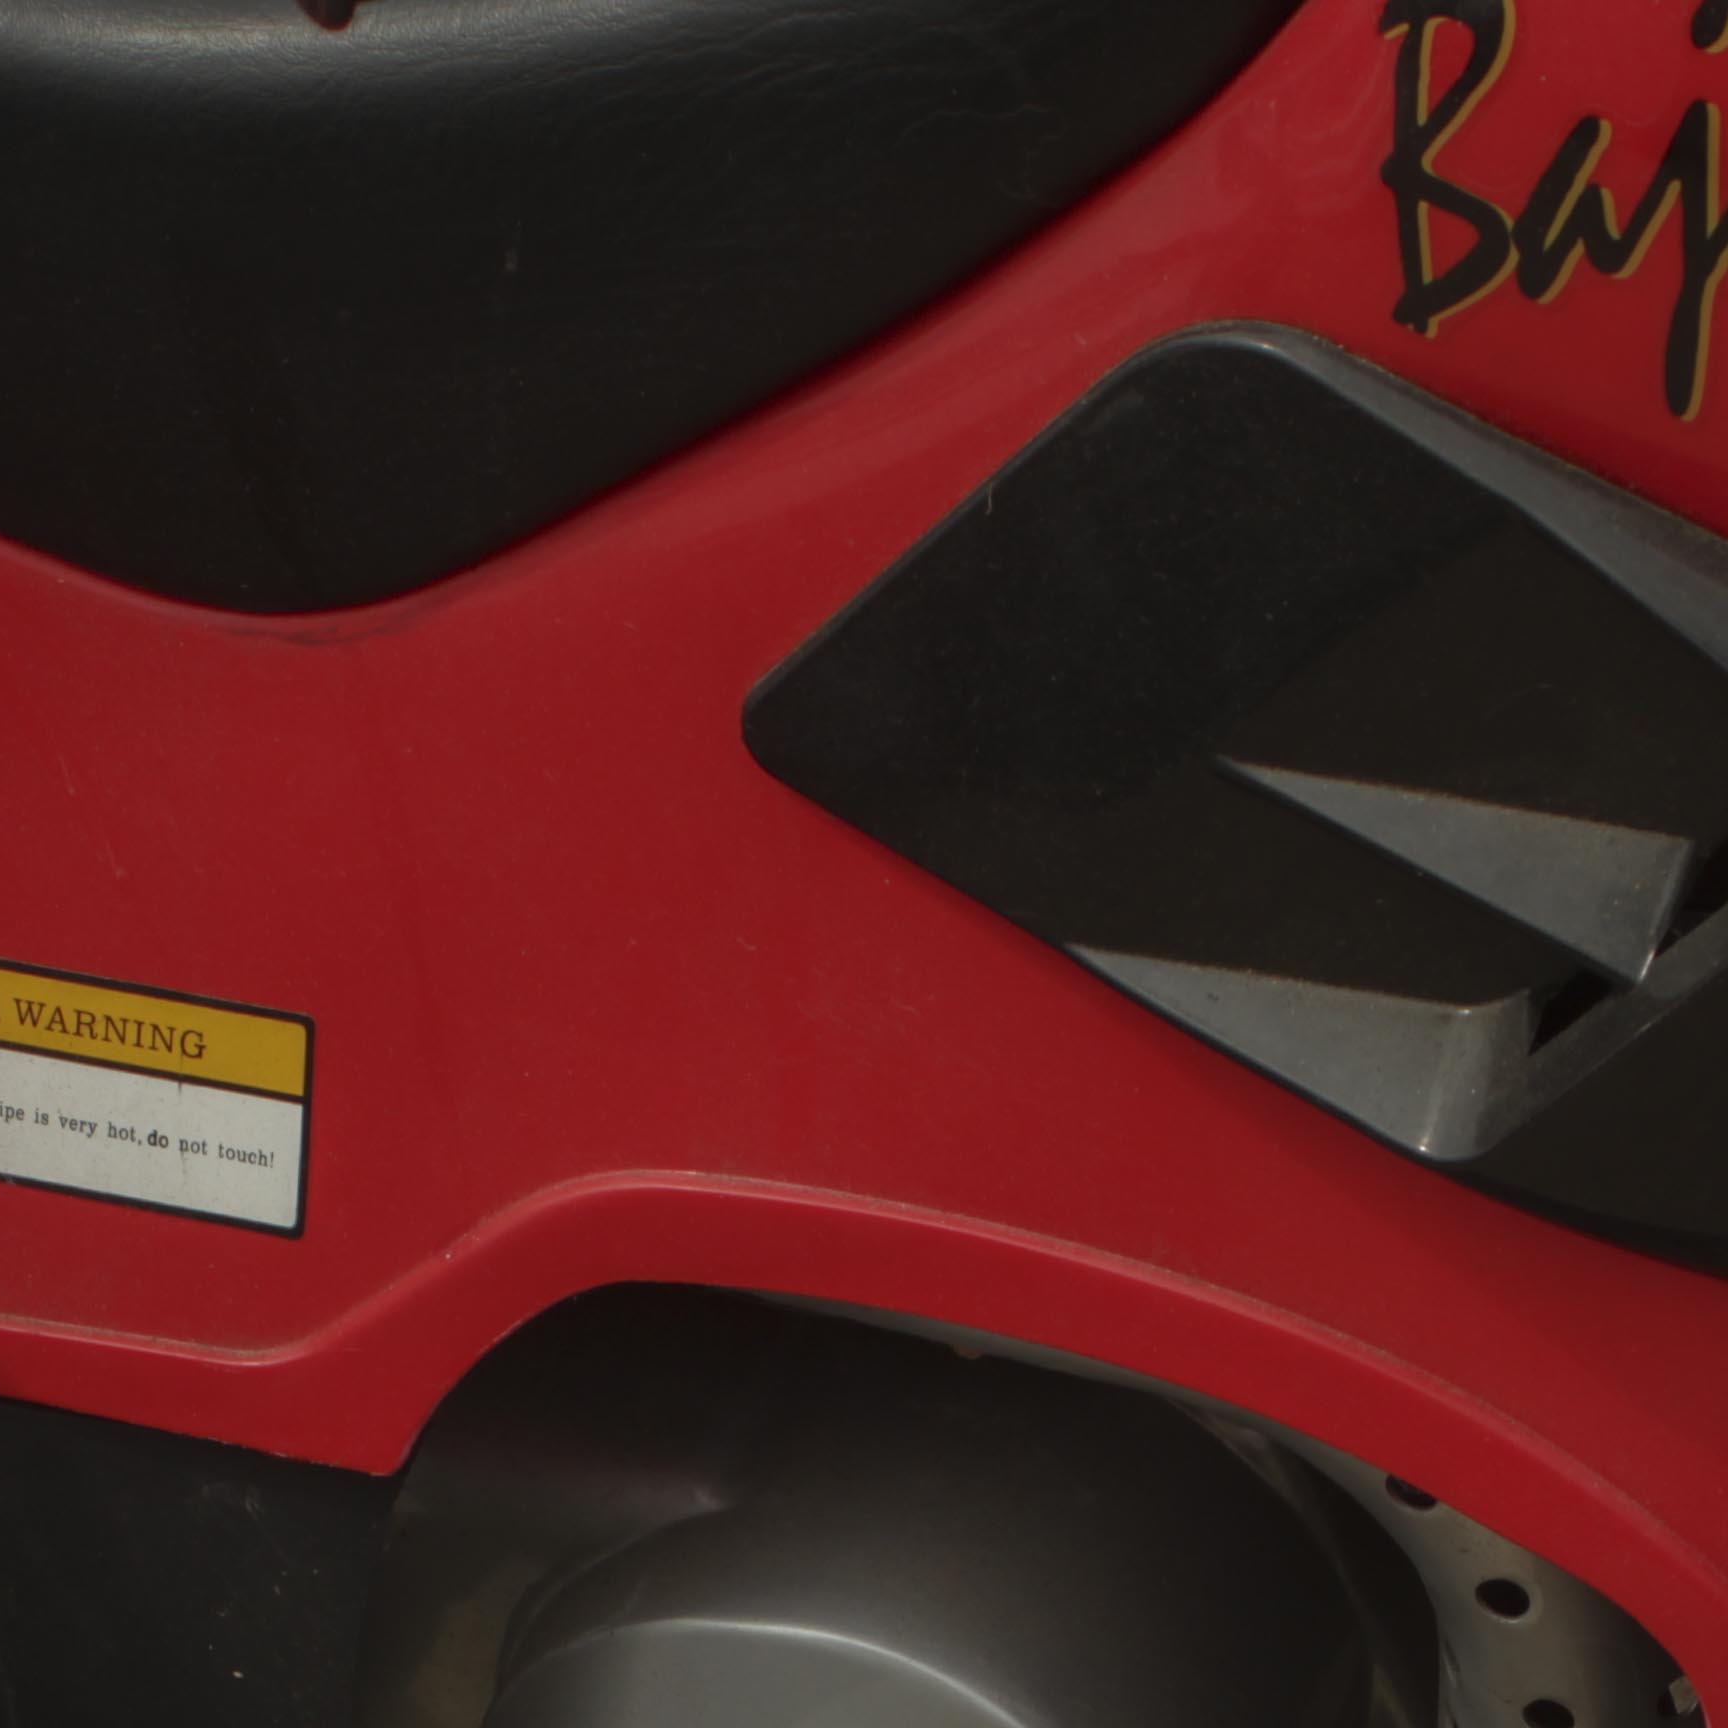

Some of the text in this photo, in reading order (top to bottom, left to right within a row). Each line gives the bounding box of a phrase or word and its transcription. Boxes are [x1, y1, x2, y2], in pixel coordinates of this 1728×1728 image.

[13, 997, 207, 1060] WARNING
[33, 1106, 50, 1127] is
[58, 1115, 98, 1138] very
[107, 1120, 143, 1146] hot,
[147, 1129, 170, 1150] do
[178, 1136, 209, 1156] not
[217, 1142, 275, 1169] touch!
